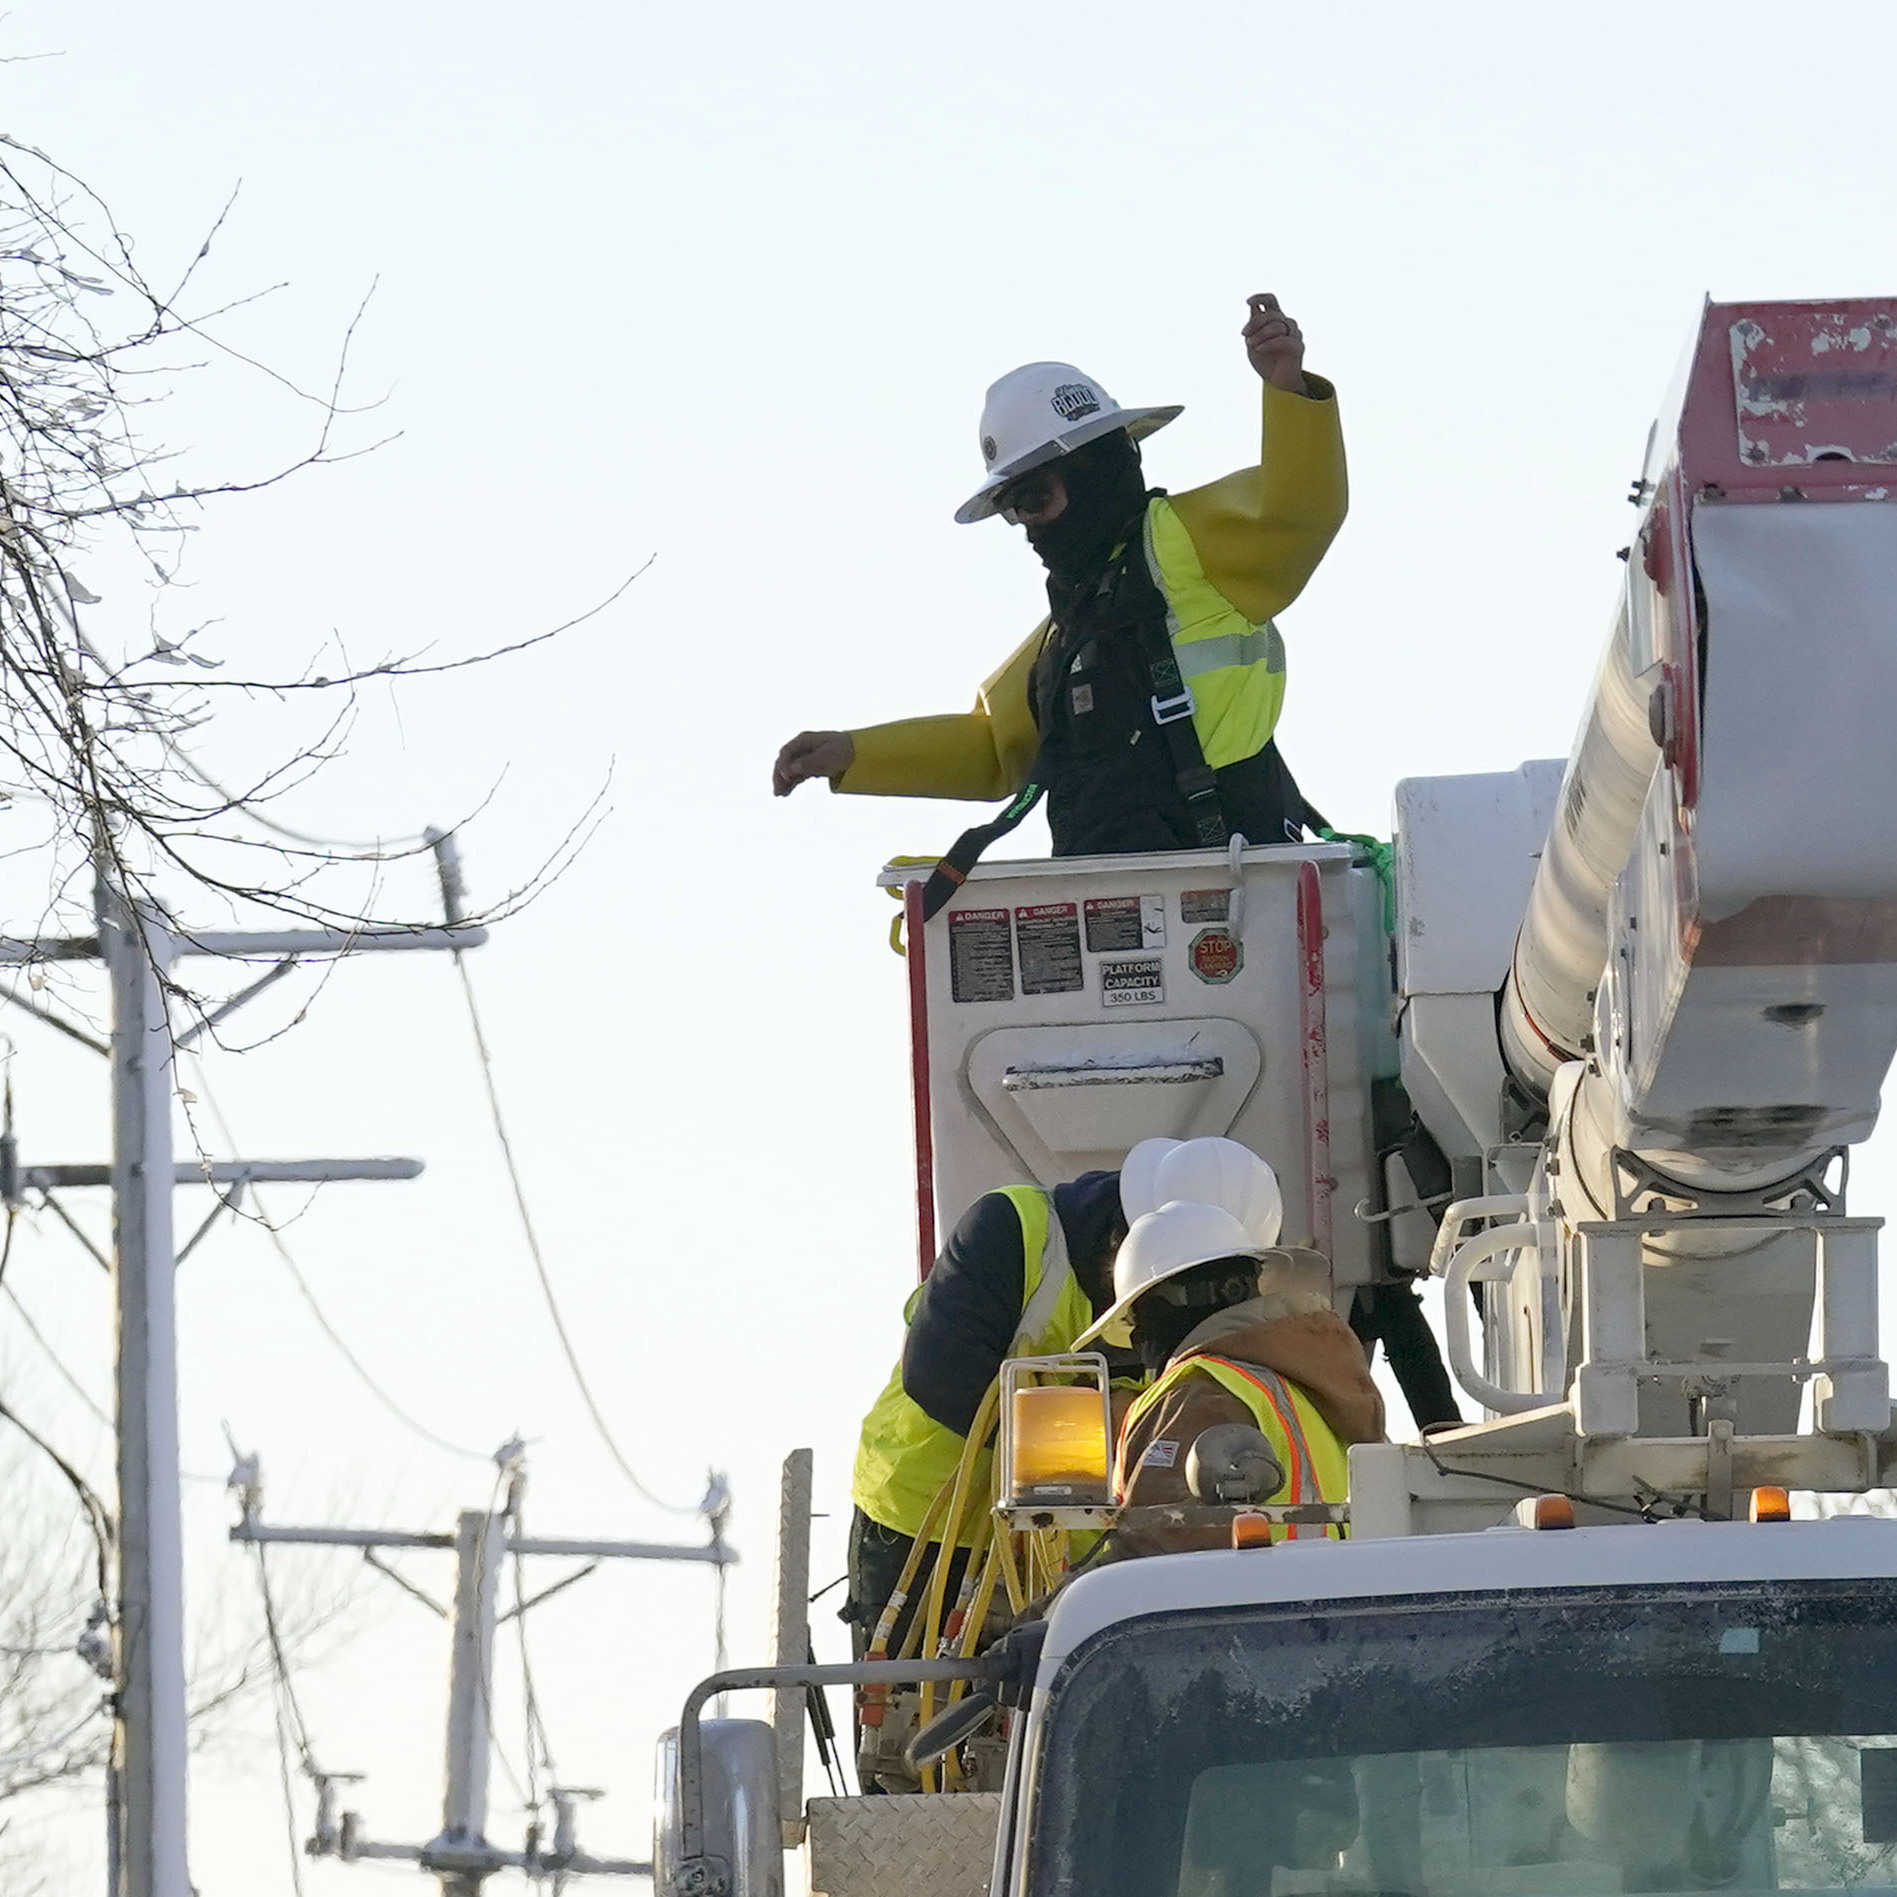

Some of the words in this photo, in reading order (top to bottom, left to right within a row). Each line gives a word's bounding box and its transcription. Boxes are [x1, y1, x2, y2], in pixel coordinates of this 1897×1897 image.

[964, 911, 1005, 921] DANGER
[1032, 905, 1068, 916] DANGER
[1200, 940, 1231, 954] STOP
[1101, 961, 1161, 976] PLATFORM
[1104, 975, 1160, 990] CAPACITY
[1110, 992, 1132, 1003] 350
[1135, 990, 1156, 1001] LBS
